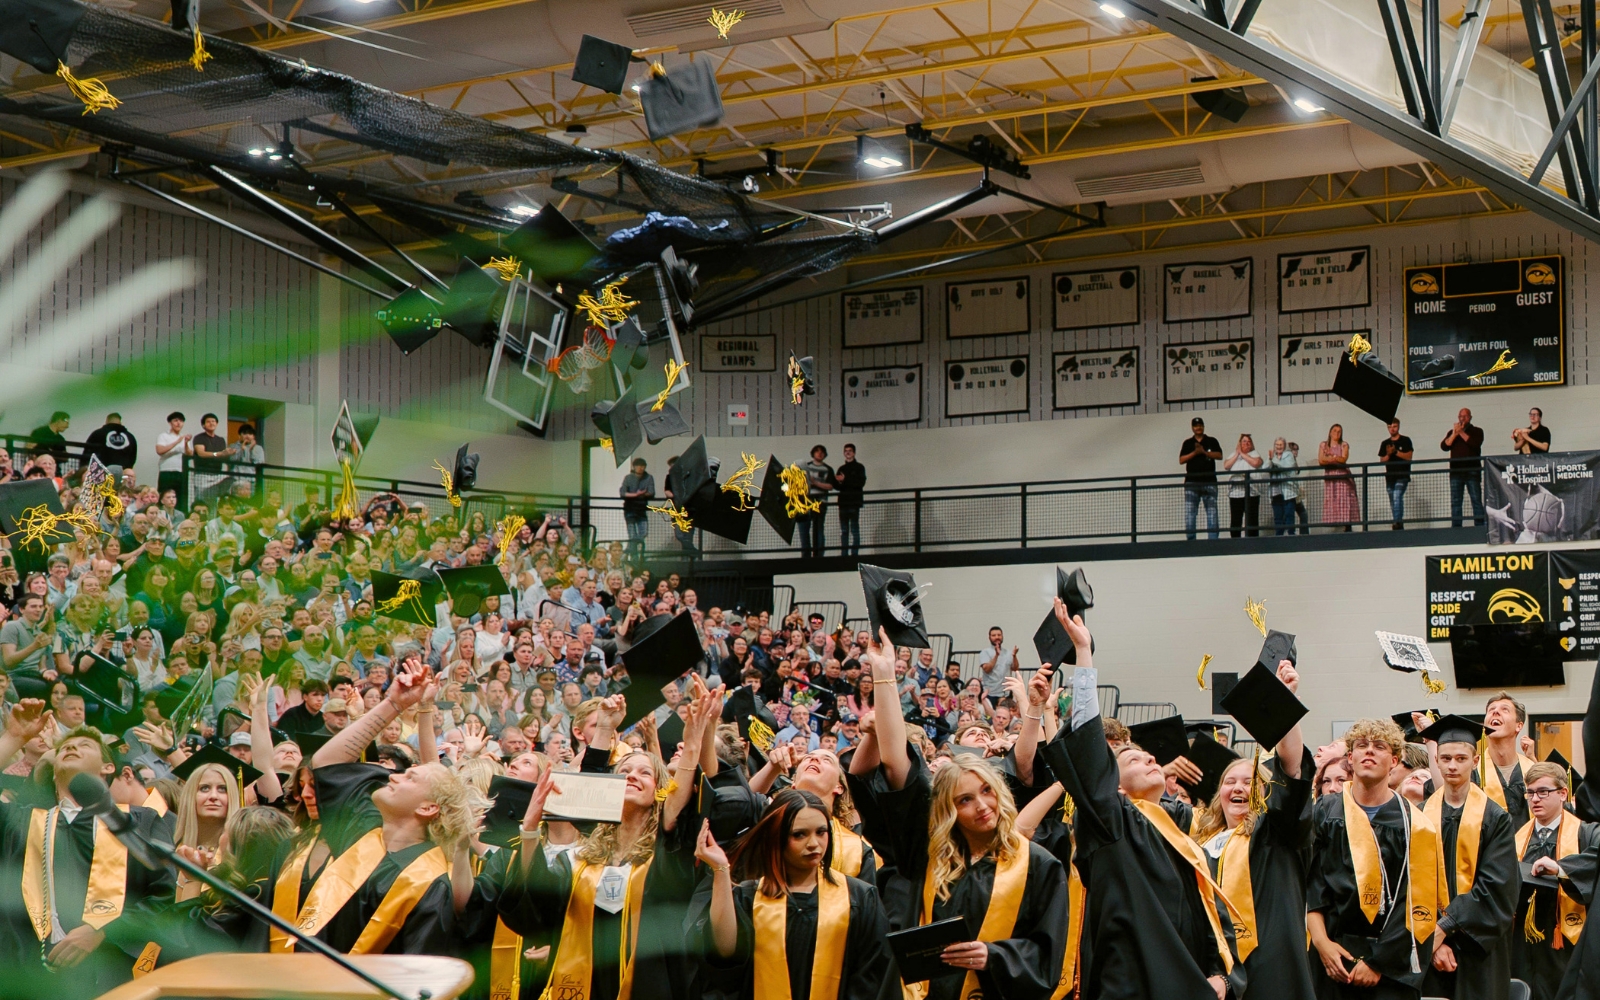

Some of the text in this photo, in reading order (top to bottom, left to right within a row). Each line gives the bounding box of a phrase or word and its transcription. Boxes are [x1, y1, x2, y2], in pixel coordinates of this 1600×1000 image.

[1516, 292, 1553, 306] GUEST
[1415, 301, 1446, 314] HOME
[1469, 304, 1496, 313] PERIOD
[717, 341, 758, 351] REGIONAL
[1326, 340, 1344, 349] TRACK
[1459, 341, 1509, 352] PLAYER FOUL
[1534, 337, 1558, 346] FOULS
[1410, 346, 1433, 355] FOULS
[722, 356, 755, 366] CHAMPS
[1470, 376, 1496, 386] MATCH
[1534, 372, 1558, 381] SCORE
[1410, 381, 1433, 390] SCORE
[1517, 465, 1548, 473] Holland
[1518, 474, 1550, 485] Hospital
[1557, 471, 1593, 479] MEDICINE
[1441, 555, 1533, 573] HAMILTON
[1431, 591, 1475, 602] RESPECT
[1431, 604, 1460, 614] PRIDE
[1431, 616, 1455, 625] GRIT
